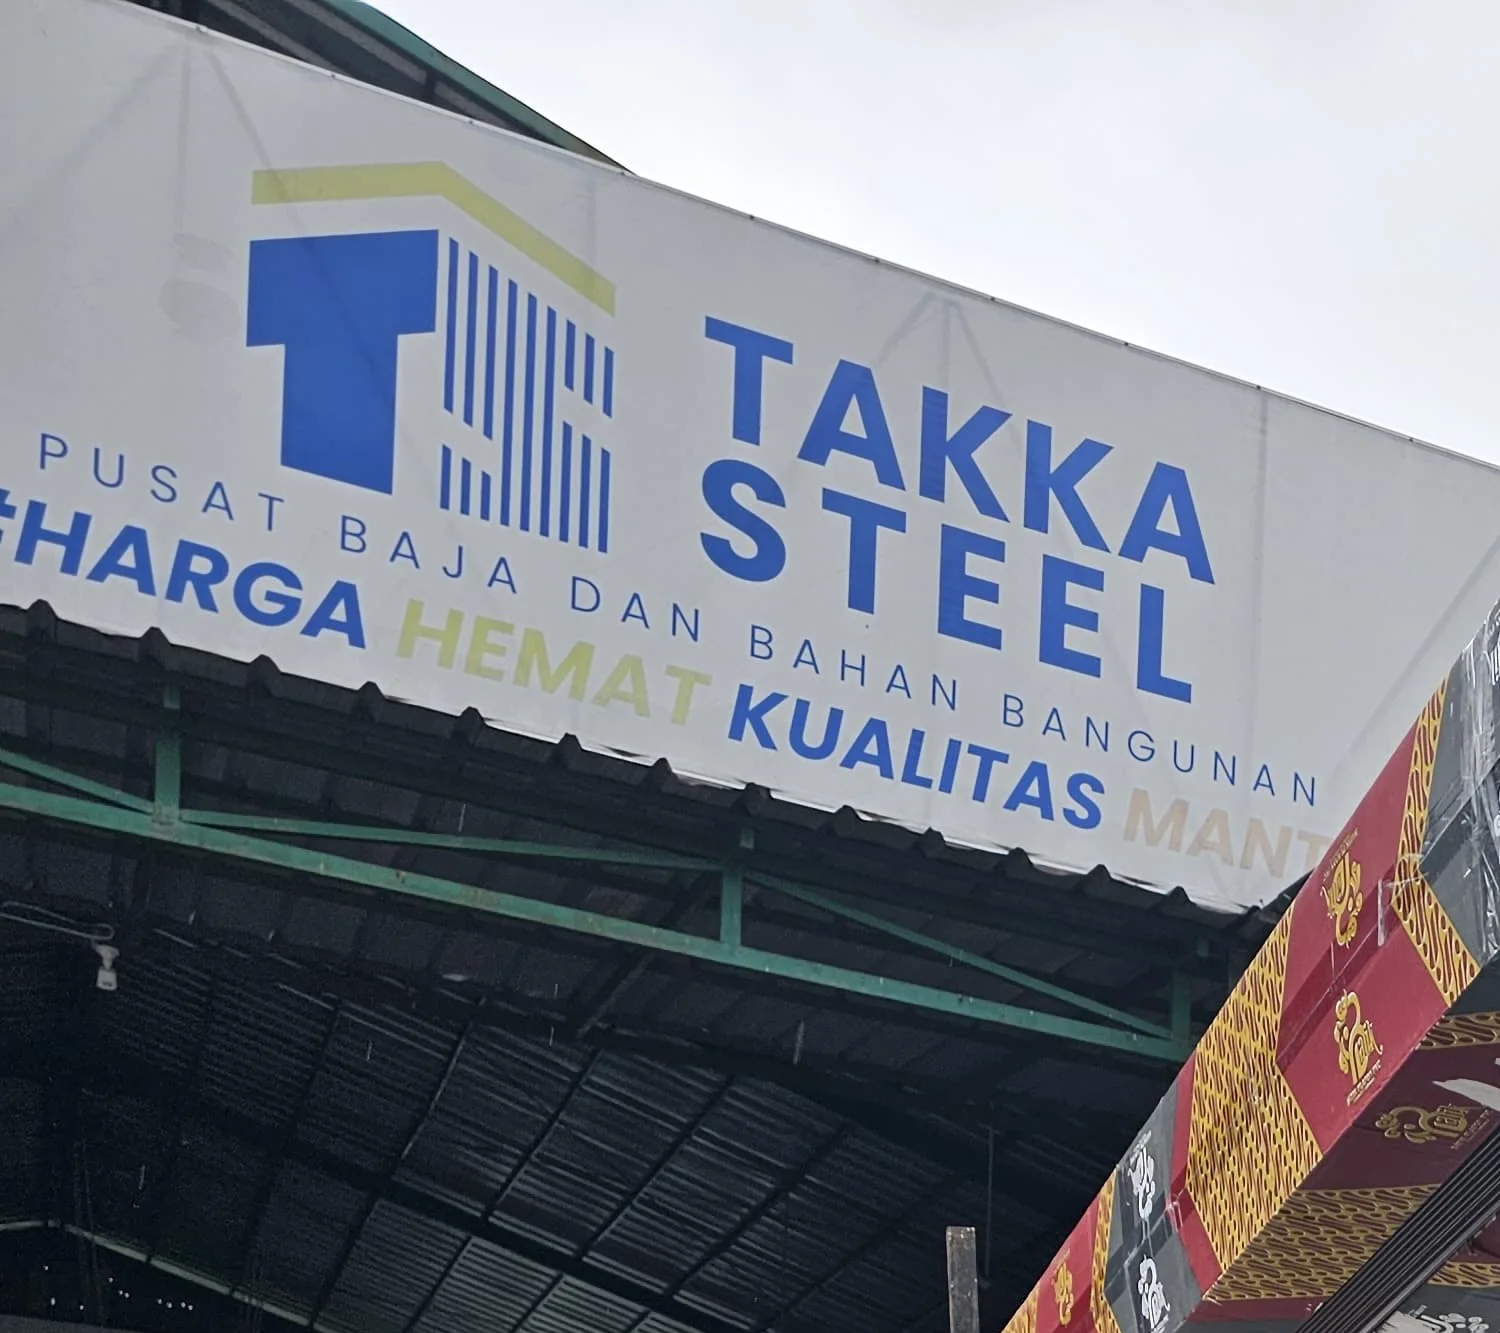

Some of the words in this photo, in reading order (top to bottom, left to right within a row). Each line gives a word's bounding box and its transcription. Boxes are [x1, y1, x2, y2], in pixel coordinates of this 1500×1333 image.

[700, 458, 1192, 703] STEEL
[703, 315, 1214, 583] TAKKA
[40, 433, 284, 531] PUSAT
[341, 515, 520, 593] BAJA
[572, 575, 700, 642] DAN
[750, 622, 960, 711] BAHAN
[1003, 693, 1317, 807] BANGUNAN
[396, 598, 711, 727] HEMAT
[728, 683, 1105, 830] KUALITAS
[1123, 787, 1335, 879] MANT
